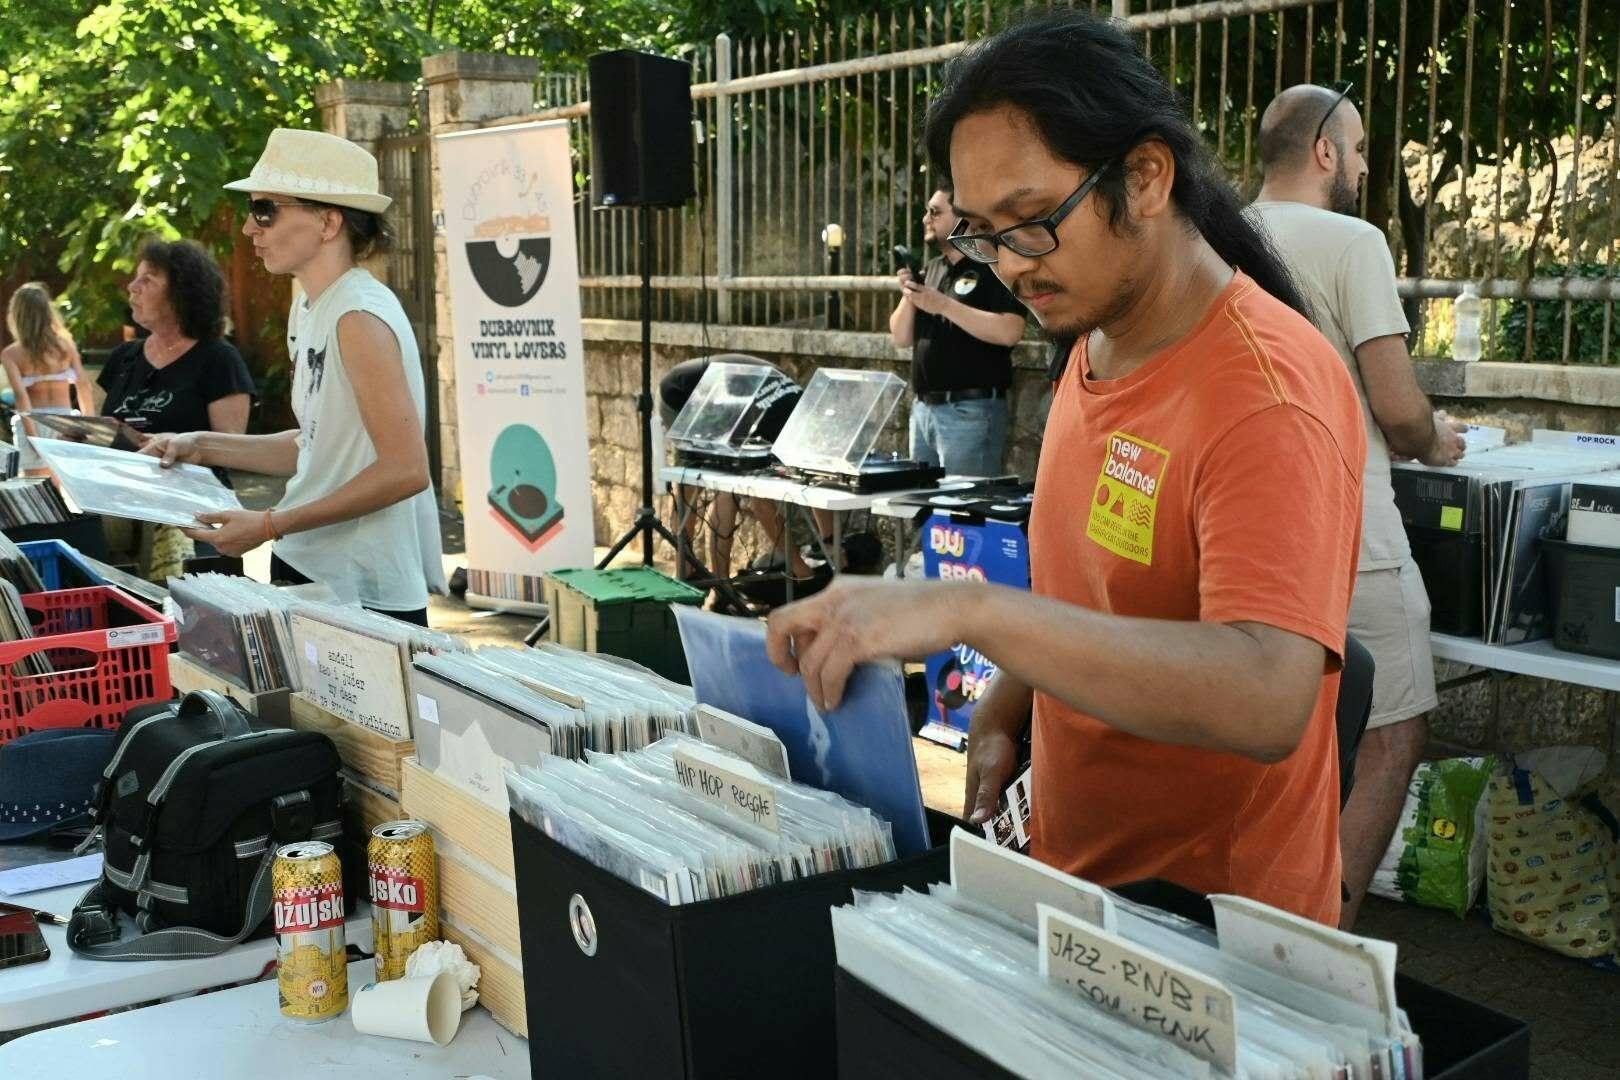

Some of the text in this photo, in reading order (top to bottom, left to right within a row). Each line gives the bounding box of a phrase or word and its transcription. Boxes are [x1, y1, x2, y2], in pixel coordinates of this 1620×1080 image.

[480, 319, 556, 337] DUBROVNIK
[471, 342, 567, 359] VINYL LOVERS
[1111, 436, 1142, 462] new
[1577, 435, 1616, 445] POP ROCK
[1105, 455, 1156, 496] balance
[930, 525, 964, 558] DU
[675, 760, 696, 789] HIP
[699, 769, 724, 798] HOP
[1050, 931, 1106, 975] JAZZ
[1142, 1005, 1215, 1053] FUNK
